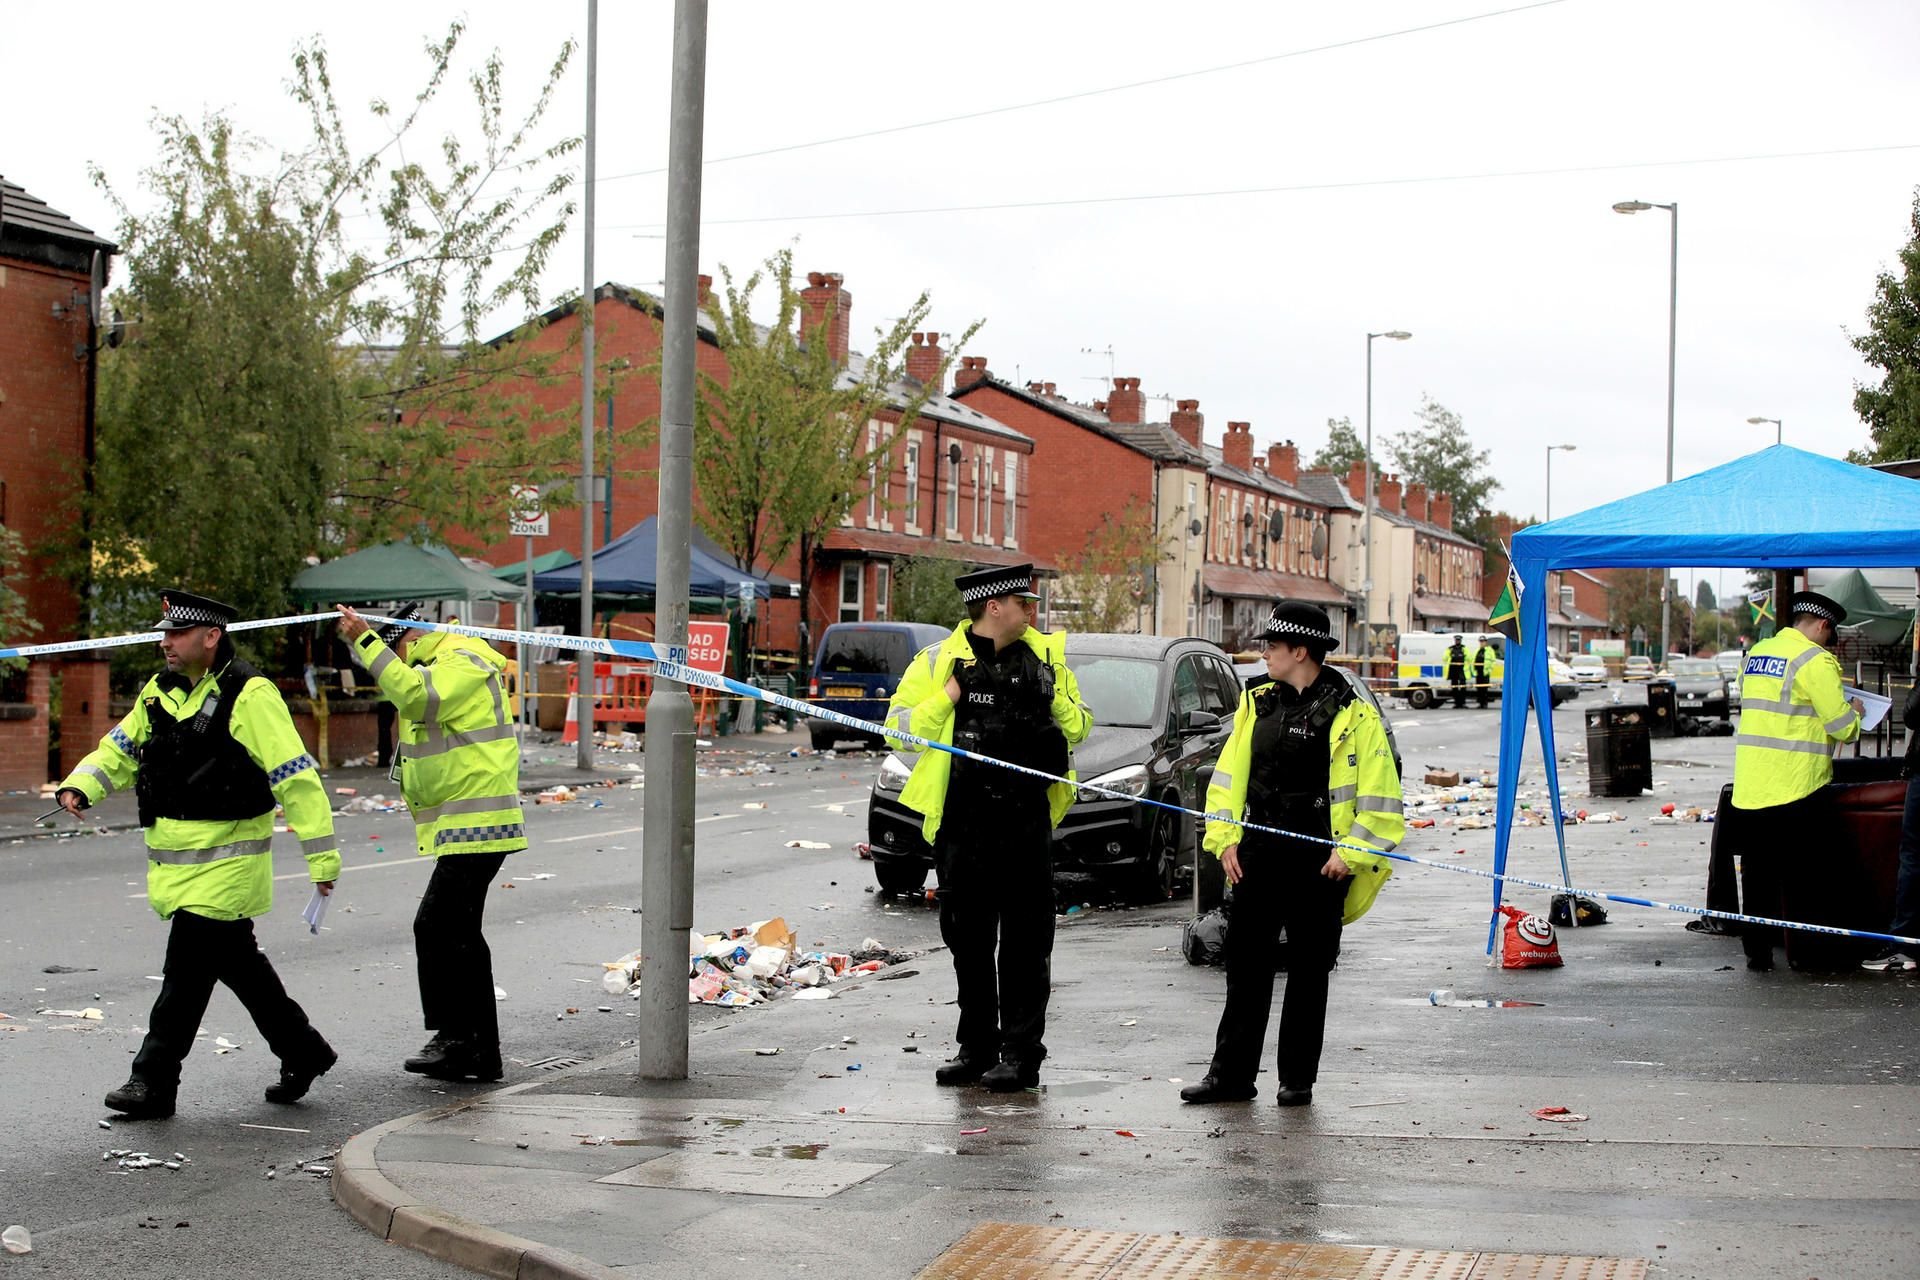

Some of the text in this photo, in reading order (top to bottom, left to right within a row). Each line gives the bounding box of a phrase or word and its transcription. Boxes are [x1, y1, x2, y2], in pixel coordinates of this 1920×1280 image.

[514, 524, 544, 534] ZONE
[687, 633, 713, 647] AD
[669, 647, 688, 664] POL
[689, 647, 721, 662] SED
[1746, 657, 1786, 675] POLICE
[968, 691, 995, 705] POLICE
[1520, 951, 1562, 959] webuy.co
